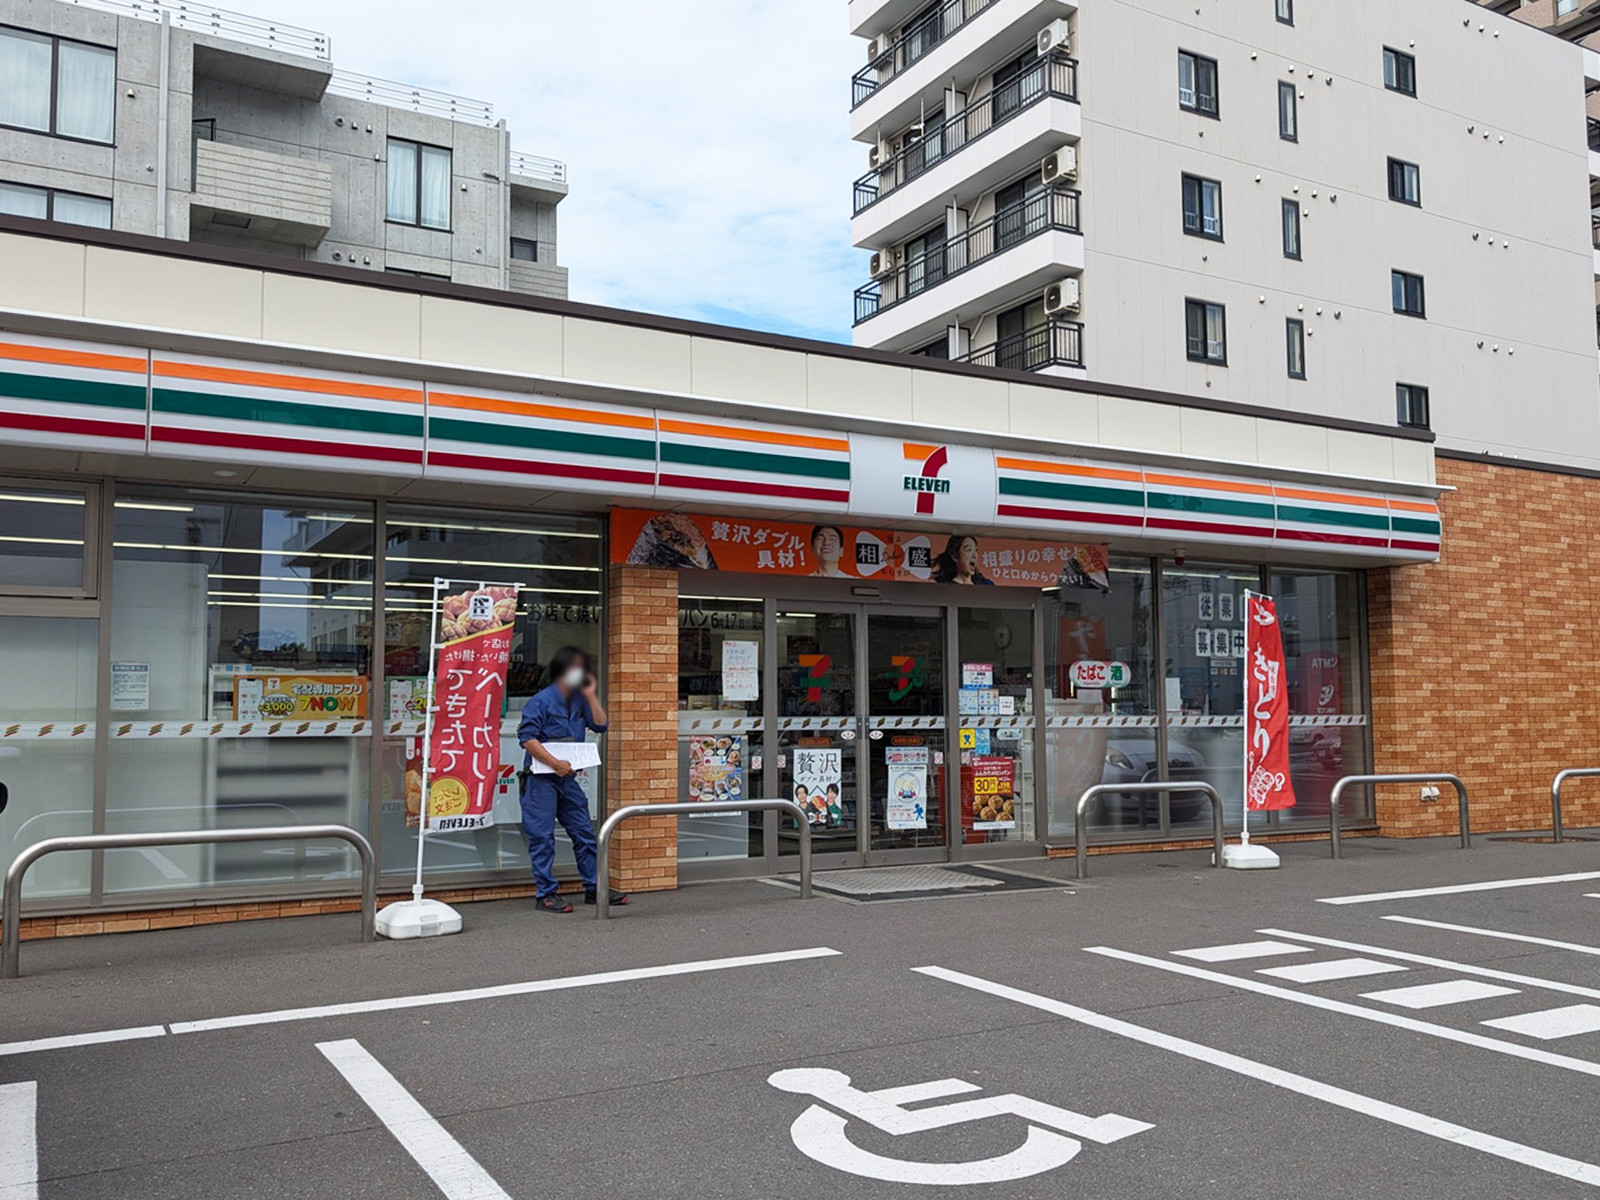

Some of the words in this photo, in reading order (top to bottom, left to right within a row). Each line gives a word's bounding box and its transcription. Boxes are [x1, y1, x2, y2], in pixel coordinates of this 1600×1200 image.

[710, 520, 805, 550] 贅沢ダブル
[757, 550, 806, 569] 具材!
[859, 545, 876, 563] 相
[911, 548, 929, 567] 盛
[1200, 595, 1246, 618] 従業
[683, 608, 708, 627] パン
[1198, 631, 1245, 655] 募集中
[1312, 657, 1333, 668] ATM
[1077, 664, 1106, 681] たばこ
[1111, 665, 1123, 681] 酒
[291, 683, 363, 695] 宅配専用アプリ
[301, 696, 356, 711] 7NOW
[797, 751, 839, 775] 贅沢
[975, 779, 990, 792] 30
